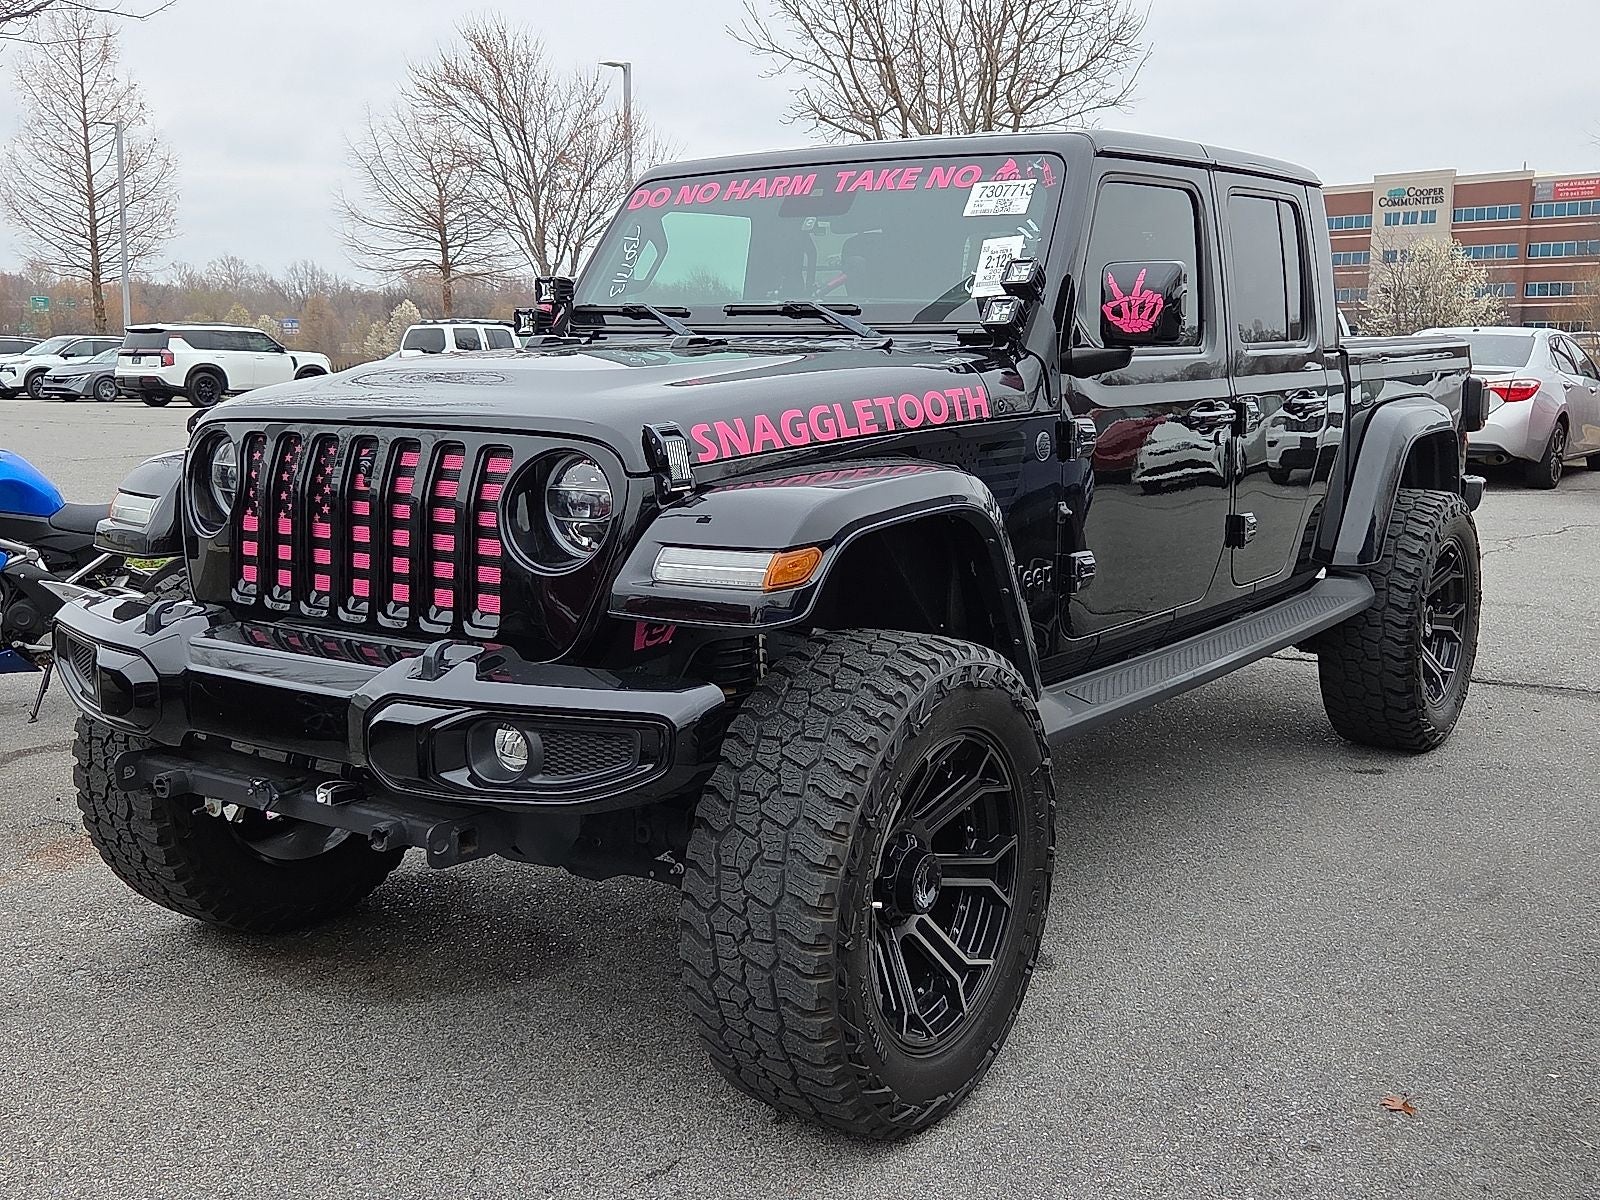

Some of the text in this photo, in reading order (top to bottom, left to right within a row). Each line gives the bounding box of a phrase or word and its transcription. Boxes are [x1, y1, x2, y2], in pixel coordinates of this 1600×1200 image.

[627, 165, 983, 210] DO NO HARM TAKE NO
[978, 183, 1036, 199] 7307713
[1379, 196, 1444, 207] COMMUNITIES
[690, 385, 990, 463] SNAGGLETOOTH
